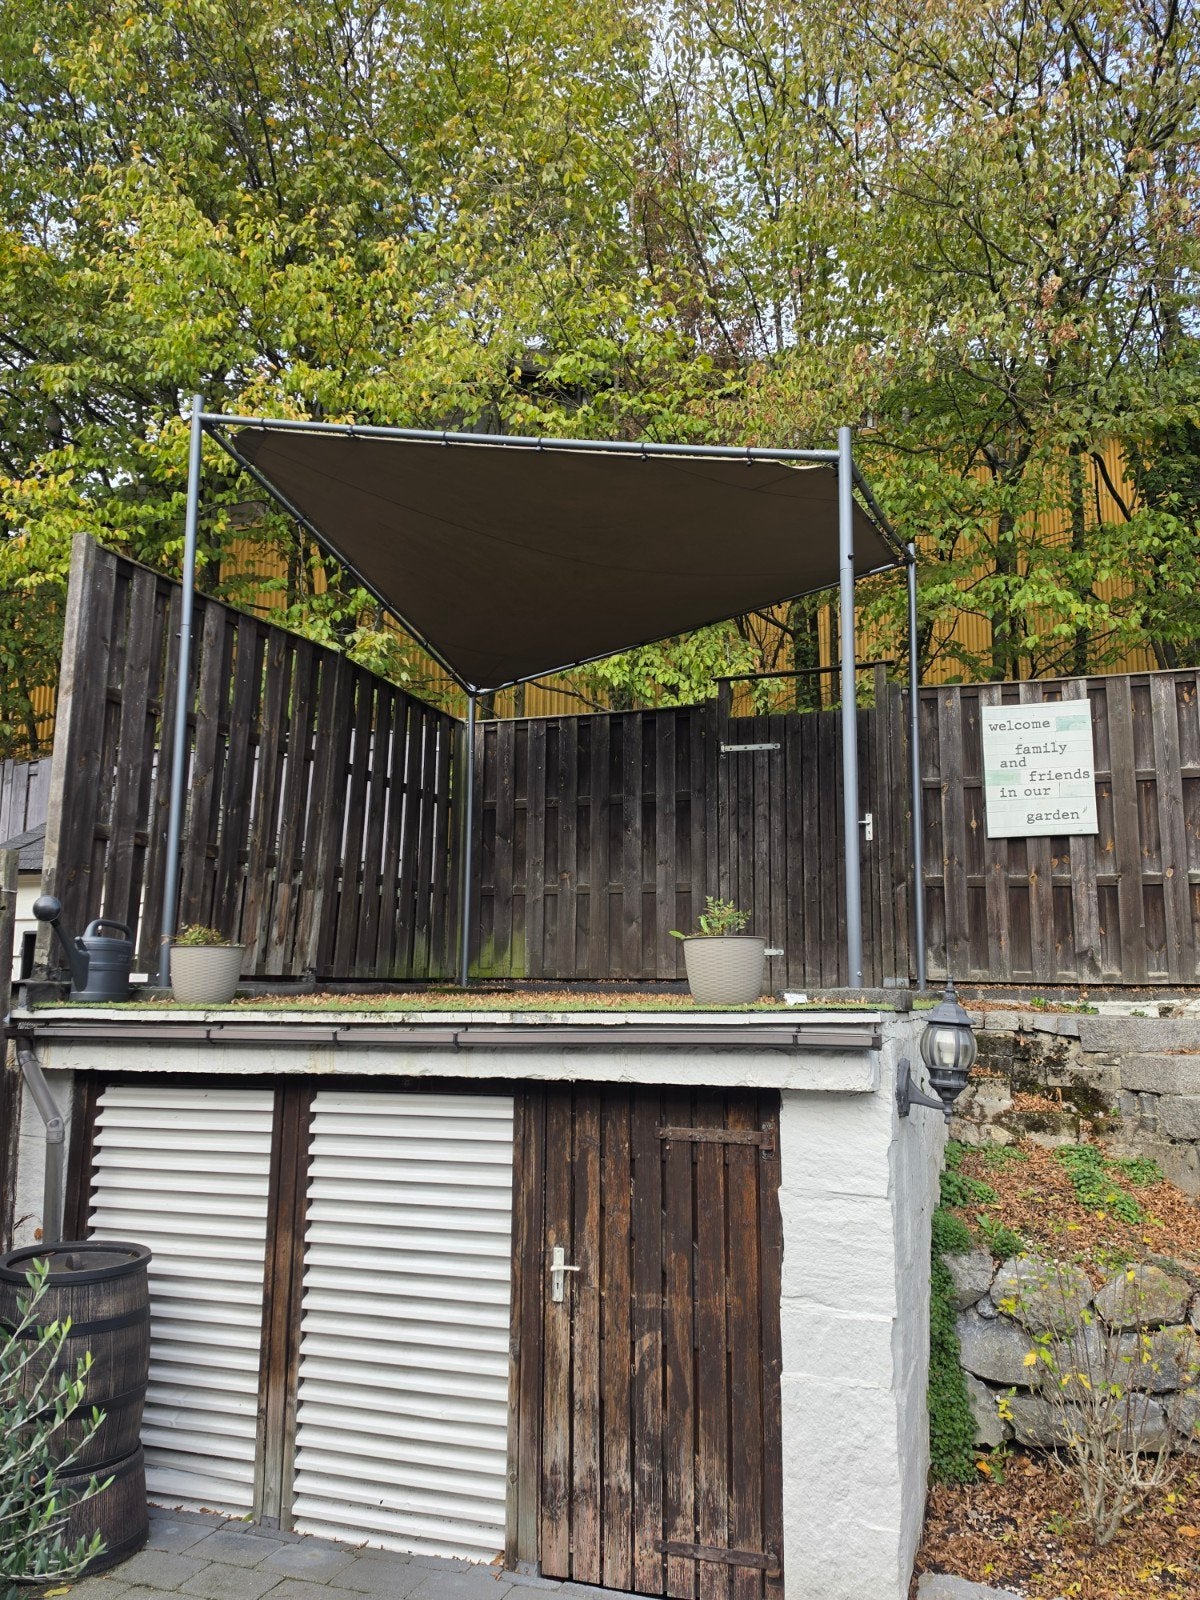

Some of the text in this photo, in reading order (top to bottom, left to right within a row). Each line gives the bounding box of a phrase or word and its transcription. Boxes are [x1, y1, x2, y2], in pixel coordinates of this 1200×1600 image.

[988, 720, 1050, 731] welcome
[1015, 742, 1067, 755] family
[1000, 757, 1027, 768] and
[1029, 769, 1090, 782] friends
[1000, 787, 1051, 798] in our
[1026, 810, 1080, 824] garden
